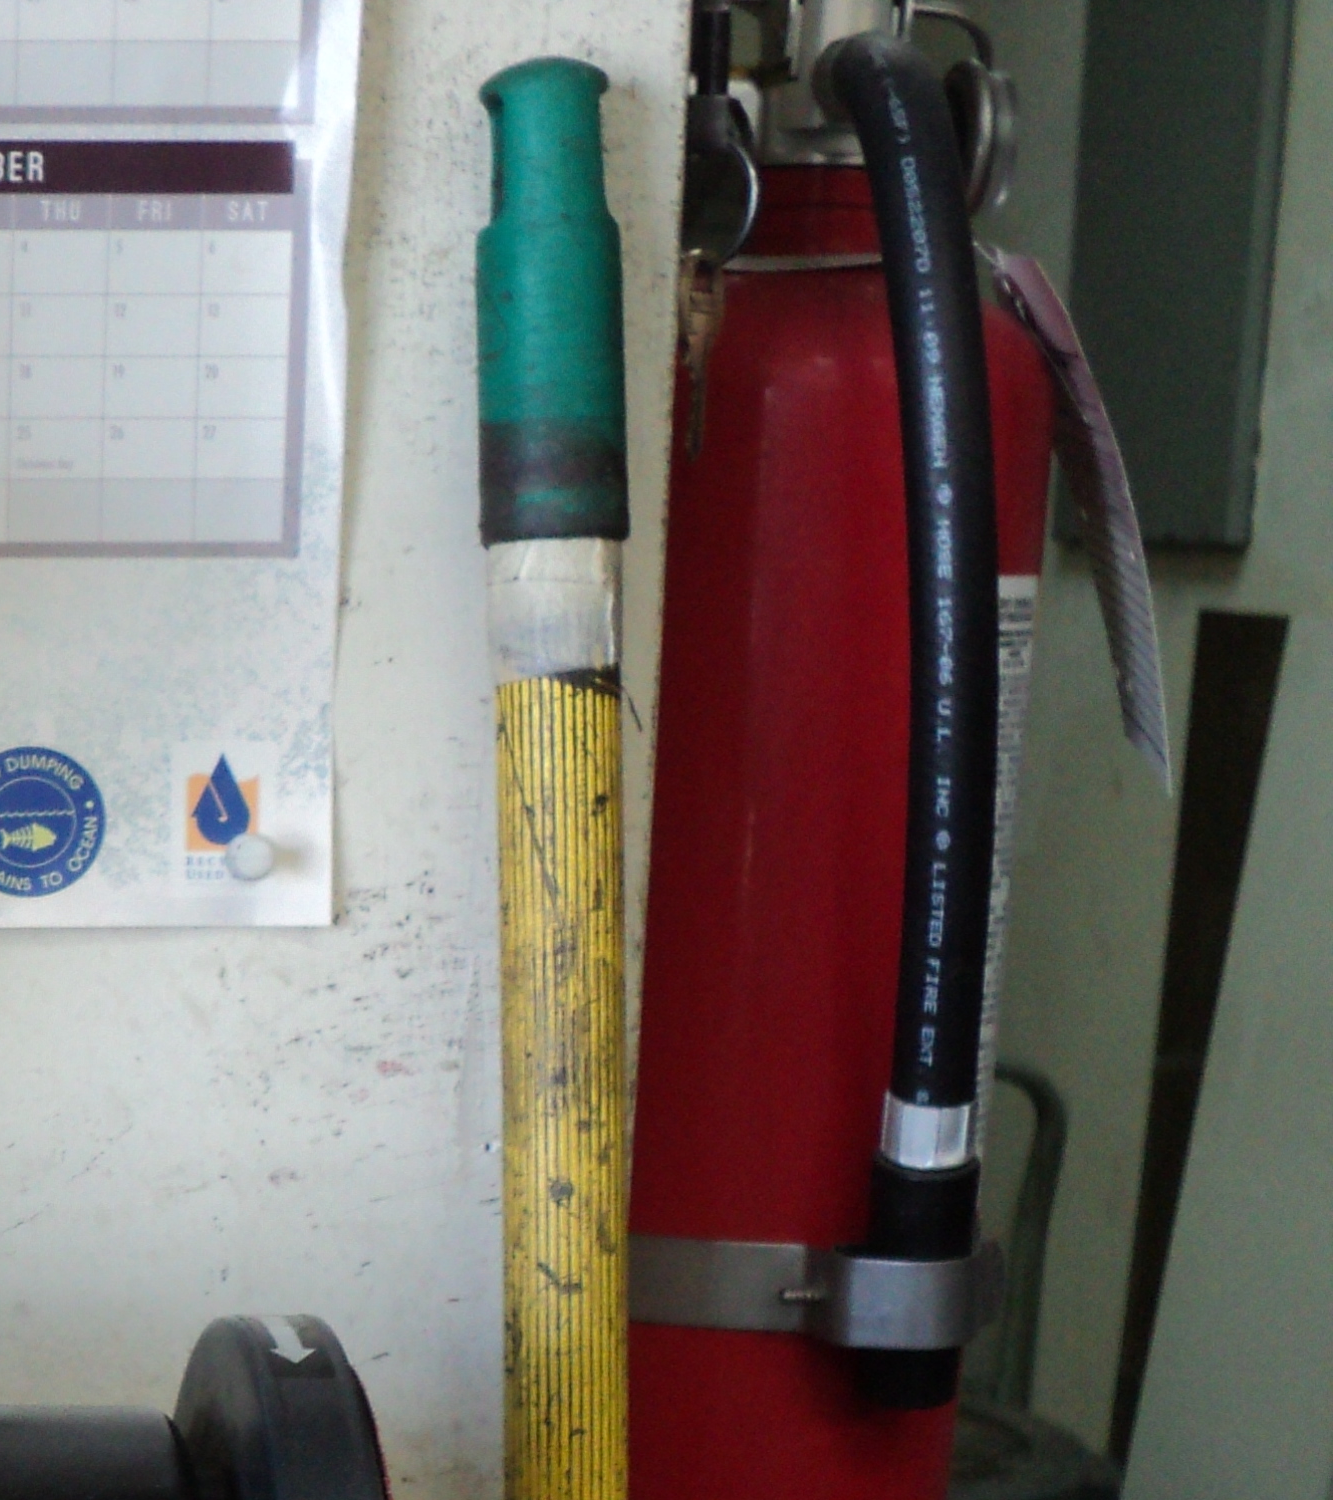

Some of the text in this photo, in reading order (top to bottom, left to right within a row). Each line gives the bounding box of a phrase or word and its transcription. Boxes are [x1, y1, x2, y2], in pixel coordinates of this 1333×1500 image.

[41, 200, 82, 223] THU
[136, 200, 172, 223] FRI
[227, 200, 270, 223] SAT
[5, 753, 85, 792] DUMPING
[39, 871, 63, 890] TO
[66, 815, 98, 872] OCEAN
[929, 861, 947, 949] LISTED
[923, 957, 941, 1014] FIRE
